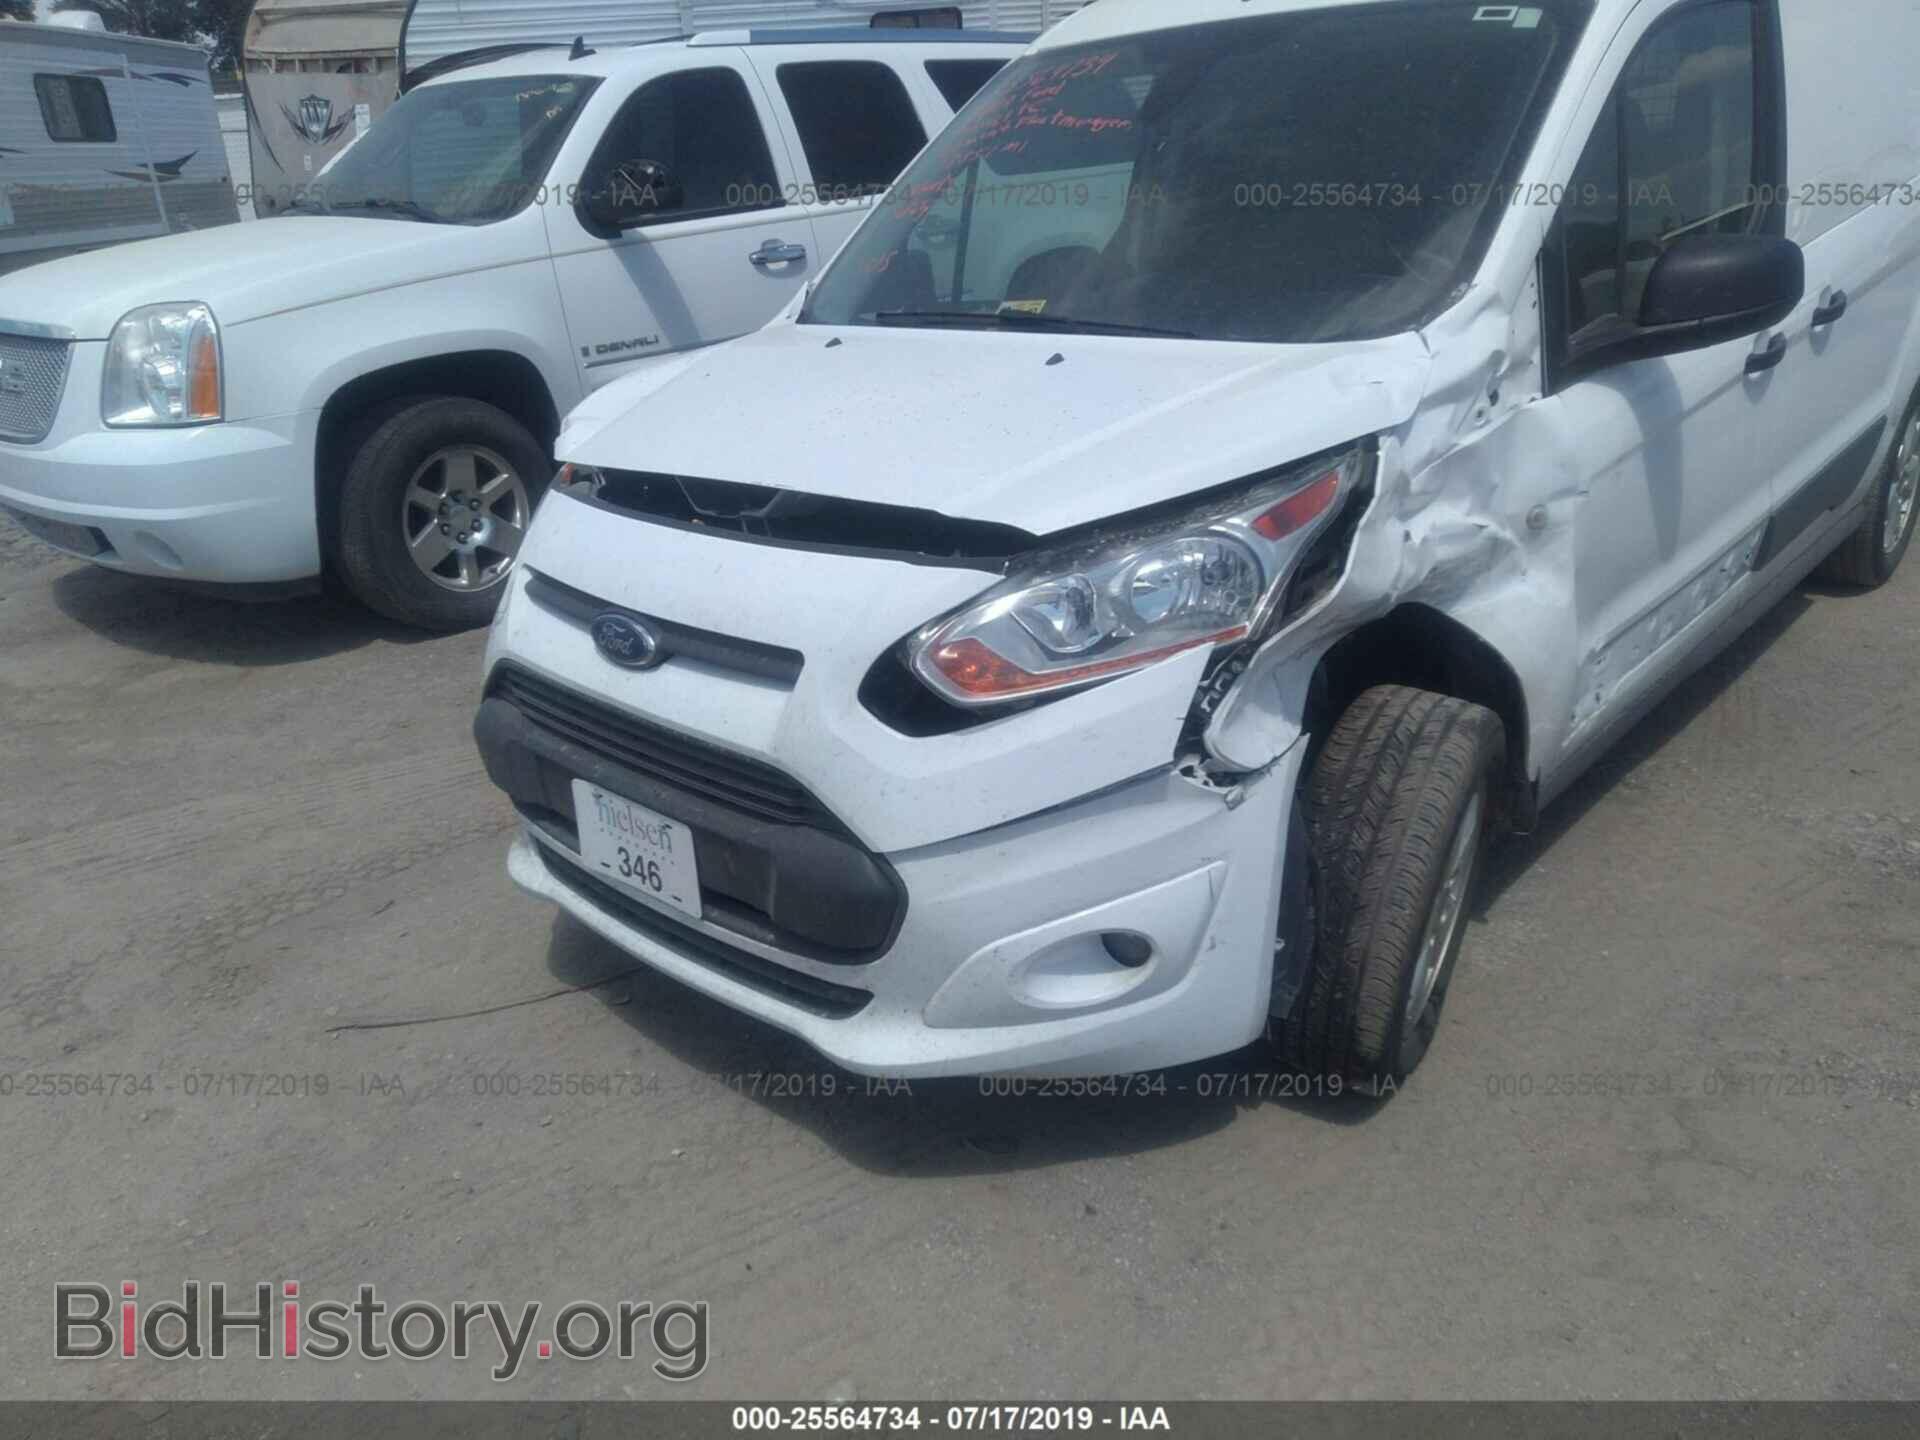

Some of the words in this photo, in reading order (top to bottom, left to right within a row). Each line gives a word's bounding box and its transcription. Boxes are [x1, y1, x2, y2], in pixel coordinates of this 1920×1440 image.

[596, 334, 659, 355] DENALI
[600, 621, 635, 656] Ford
[618, 846, 664, 893] 346
